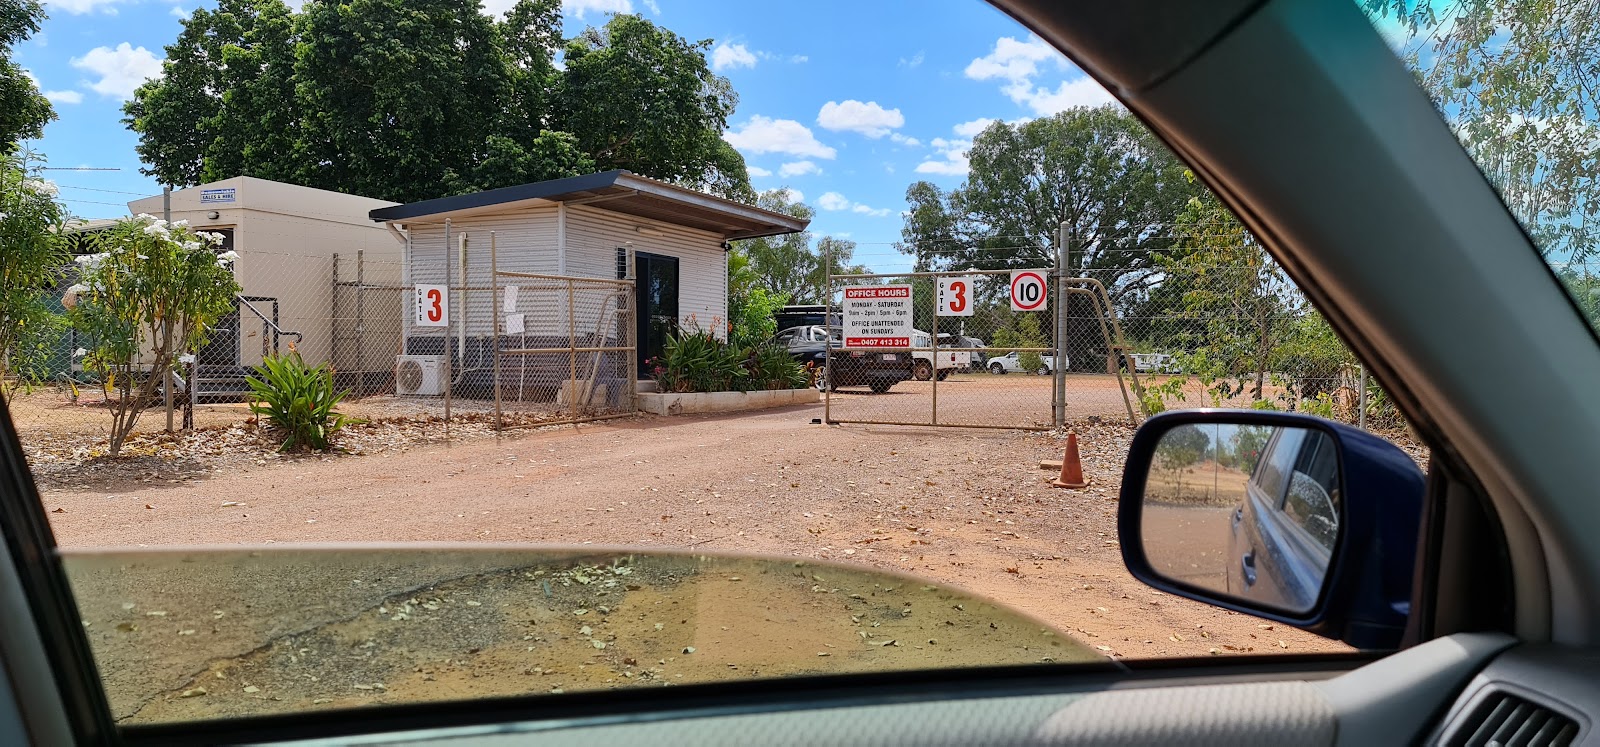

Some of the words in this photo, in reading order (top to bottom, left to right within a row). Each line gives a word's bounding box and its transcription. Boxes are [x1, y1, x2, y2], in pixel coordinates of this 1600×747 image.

[878, 289, 907, 297] HOURS
[949, 281, 966, 312] 3
[1020, 282, 1039, 302] 10
[427, 288, 442, 322] 3
